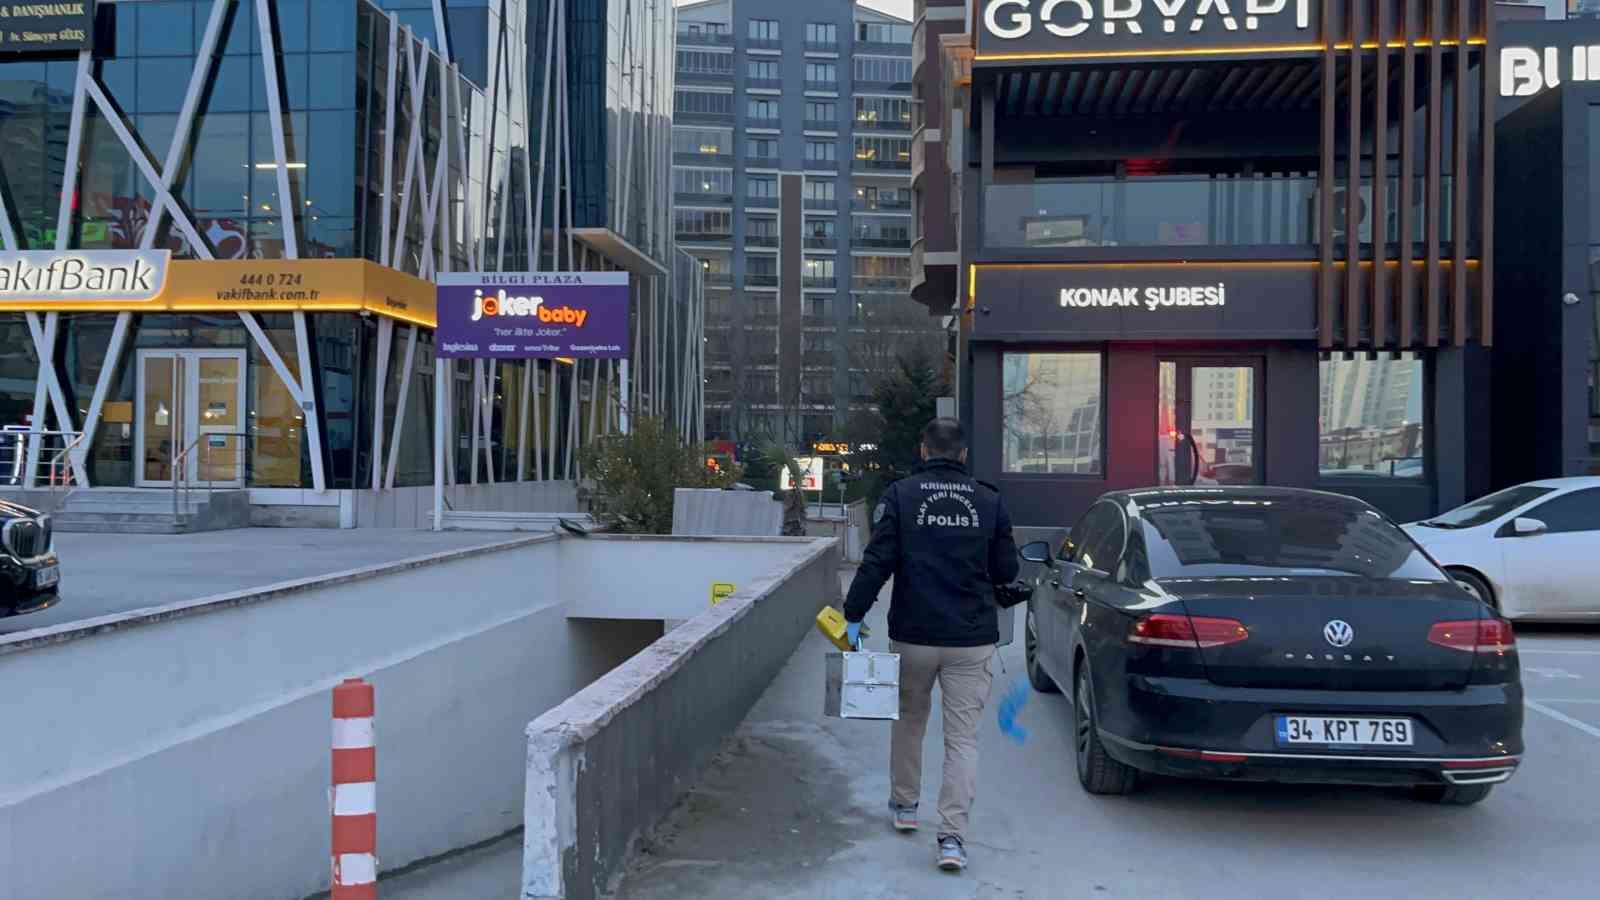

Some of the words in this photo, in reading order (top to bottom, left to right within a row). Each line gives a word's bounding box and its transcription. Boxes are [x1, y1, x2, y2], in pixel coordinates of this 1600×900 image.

[240, 273, 262, 285] 444
[266, 274, 275, 285] 0
[279, 274, 302, 286] 724
[533, 275, 584, 284] PLAZA
[471, 289, 543, 321] joker
[1060, 288, 1139, 307] KONAK
[1144, 282, 1225, 311] ŞUBESİ
[539, 306, 589, 327] baby
[927, 514, 970, 527] POLİS
[1288, 719, 1312, 741] 34
[1323, 719, 1360, 742] KPT
[1369, 721, 1407, 743] 769
